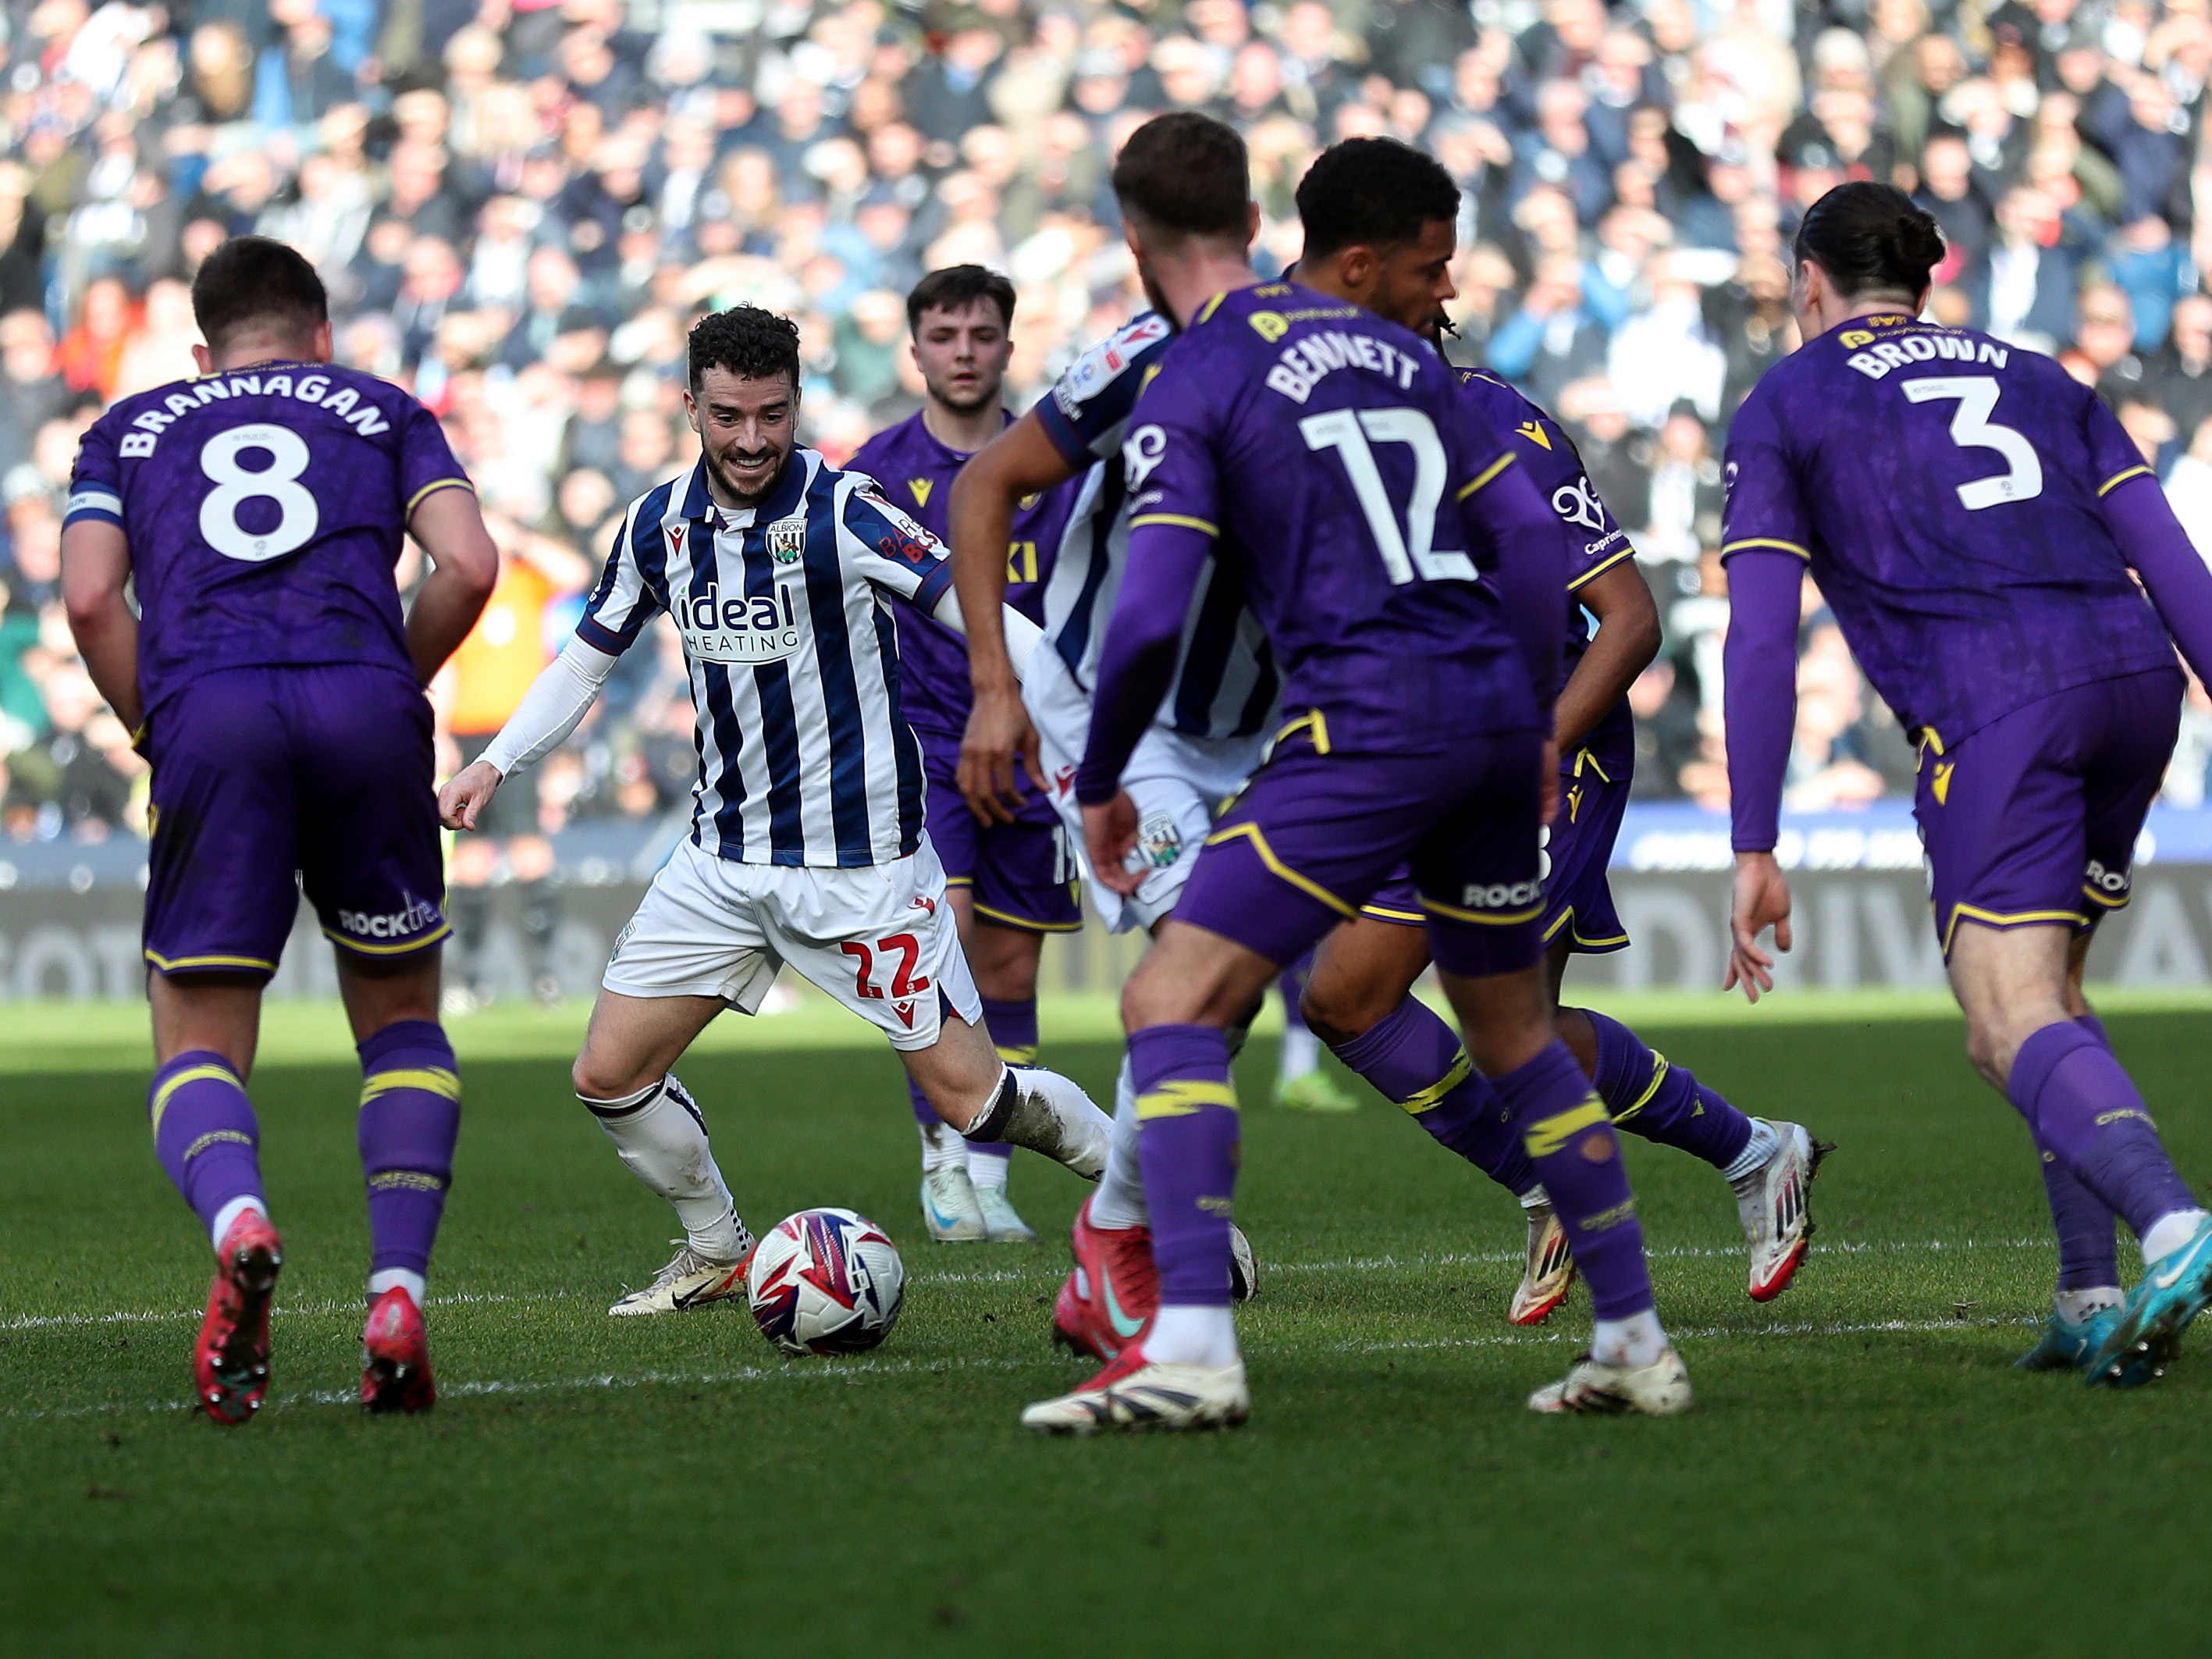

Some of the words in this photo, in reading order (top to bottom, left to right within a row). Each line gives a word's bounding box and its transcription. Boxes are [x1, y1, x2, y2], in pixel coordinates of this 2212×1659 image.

[1265, 330, 1421, 405] BENNETT
[1847, 336, 2009, 380] BROWN
[119, 374, 391, 459] BRANNAGAN
[1900, 375, 2044, 511] 3
[200, 422, 319, 562] 8
[1297, 407, 1480, 586] 12
[770, 524, 803, 532] ALBION
[680, 584, 795, 631] ideal
[685, 631, 798, 653] HEATING
[840, 933, 930, 999] 22
